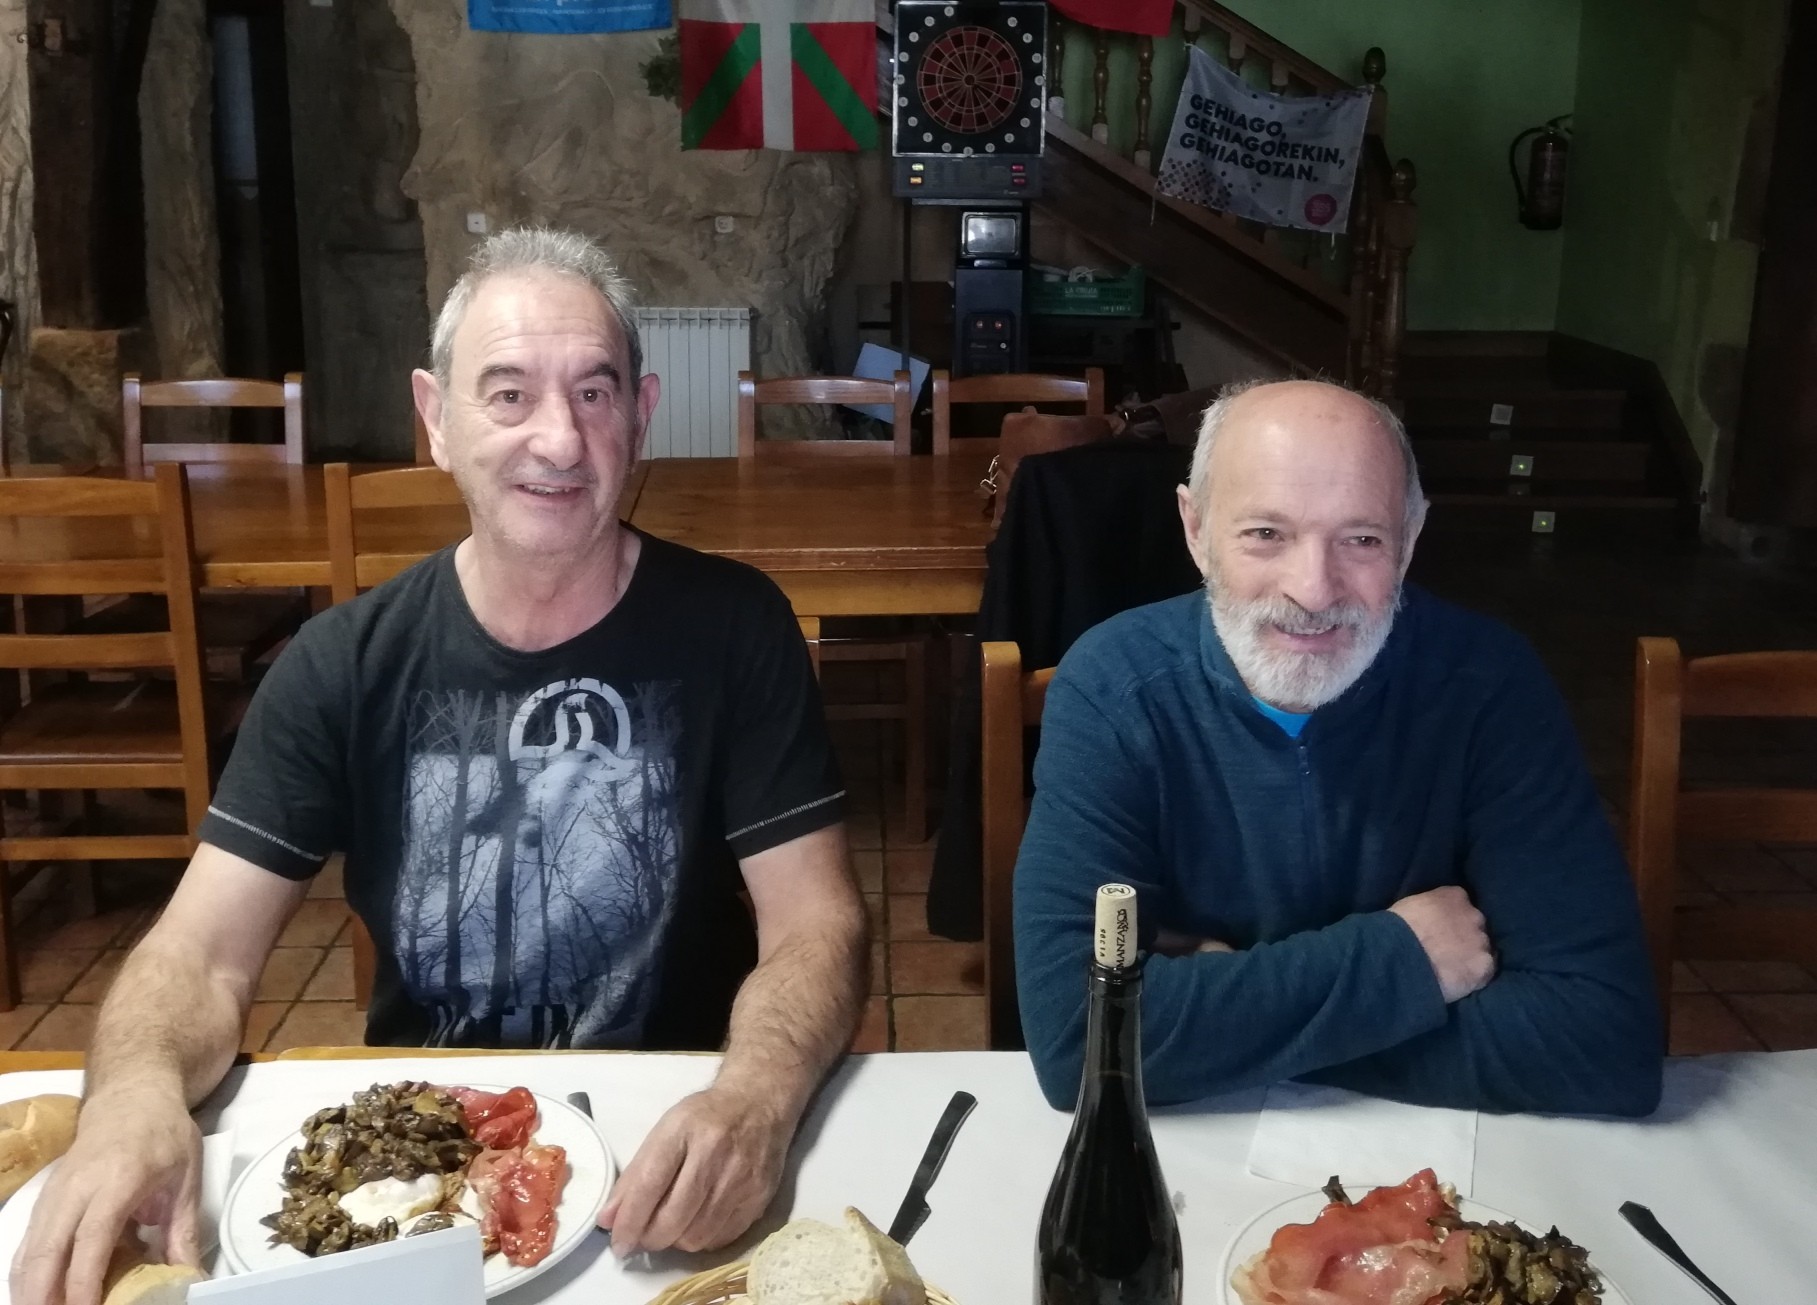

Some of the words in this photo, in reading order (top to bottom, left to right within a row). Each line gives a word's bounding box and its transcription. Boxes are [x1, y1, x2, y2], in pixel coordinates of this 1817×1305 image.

[1185, 113, 1345, 169] GEHIAGOREKIN,
[1190, 94, 1286, 140] GEHIAGO,
[1180, 133, 1318, 182] GEHIAGOTAN.
